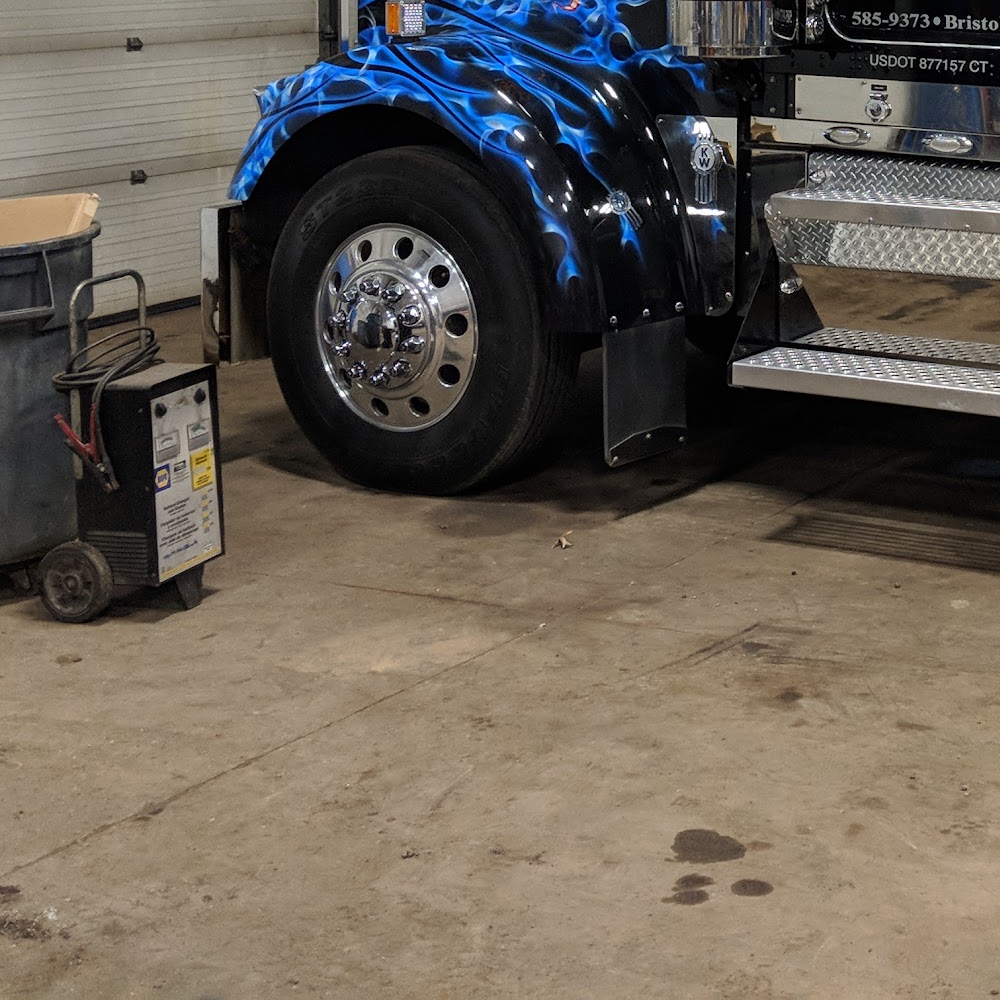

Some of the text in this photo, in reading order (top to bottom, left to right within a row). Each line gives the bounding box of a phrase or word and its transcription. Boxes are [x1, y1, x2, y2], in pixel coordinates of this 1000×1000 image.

[851, 11, 931, 29] 585-9373
[869, 53, 989, 74] USDOT 877157 CT
